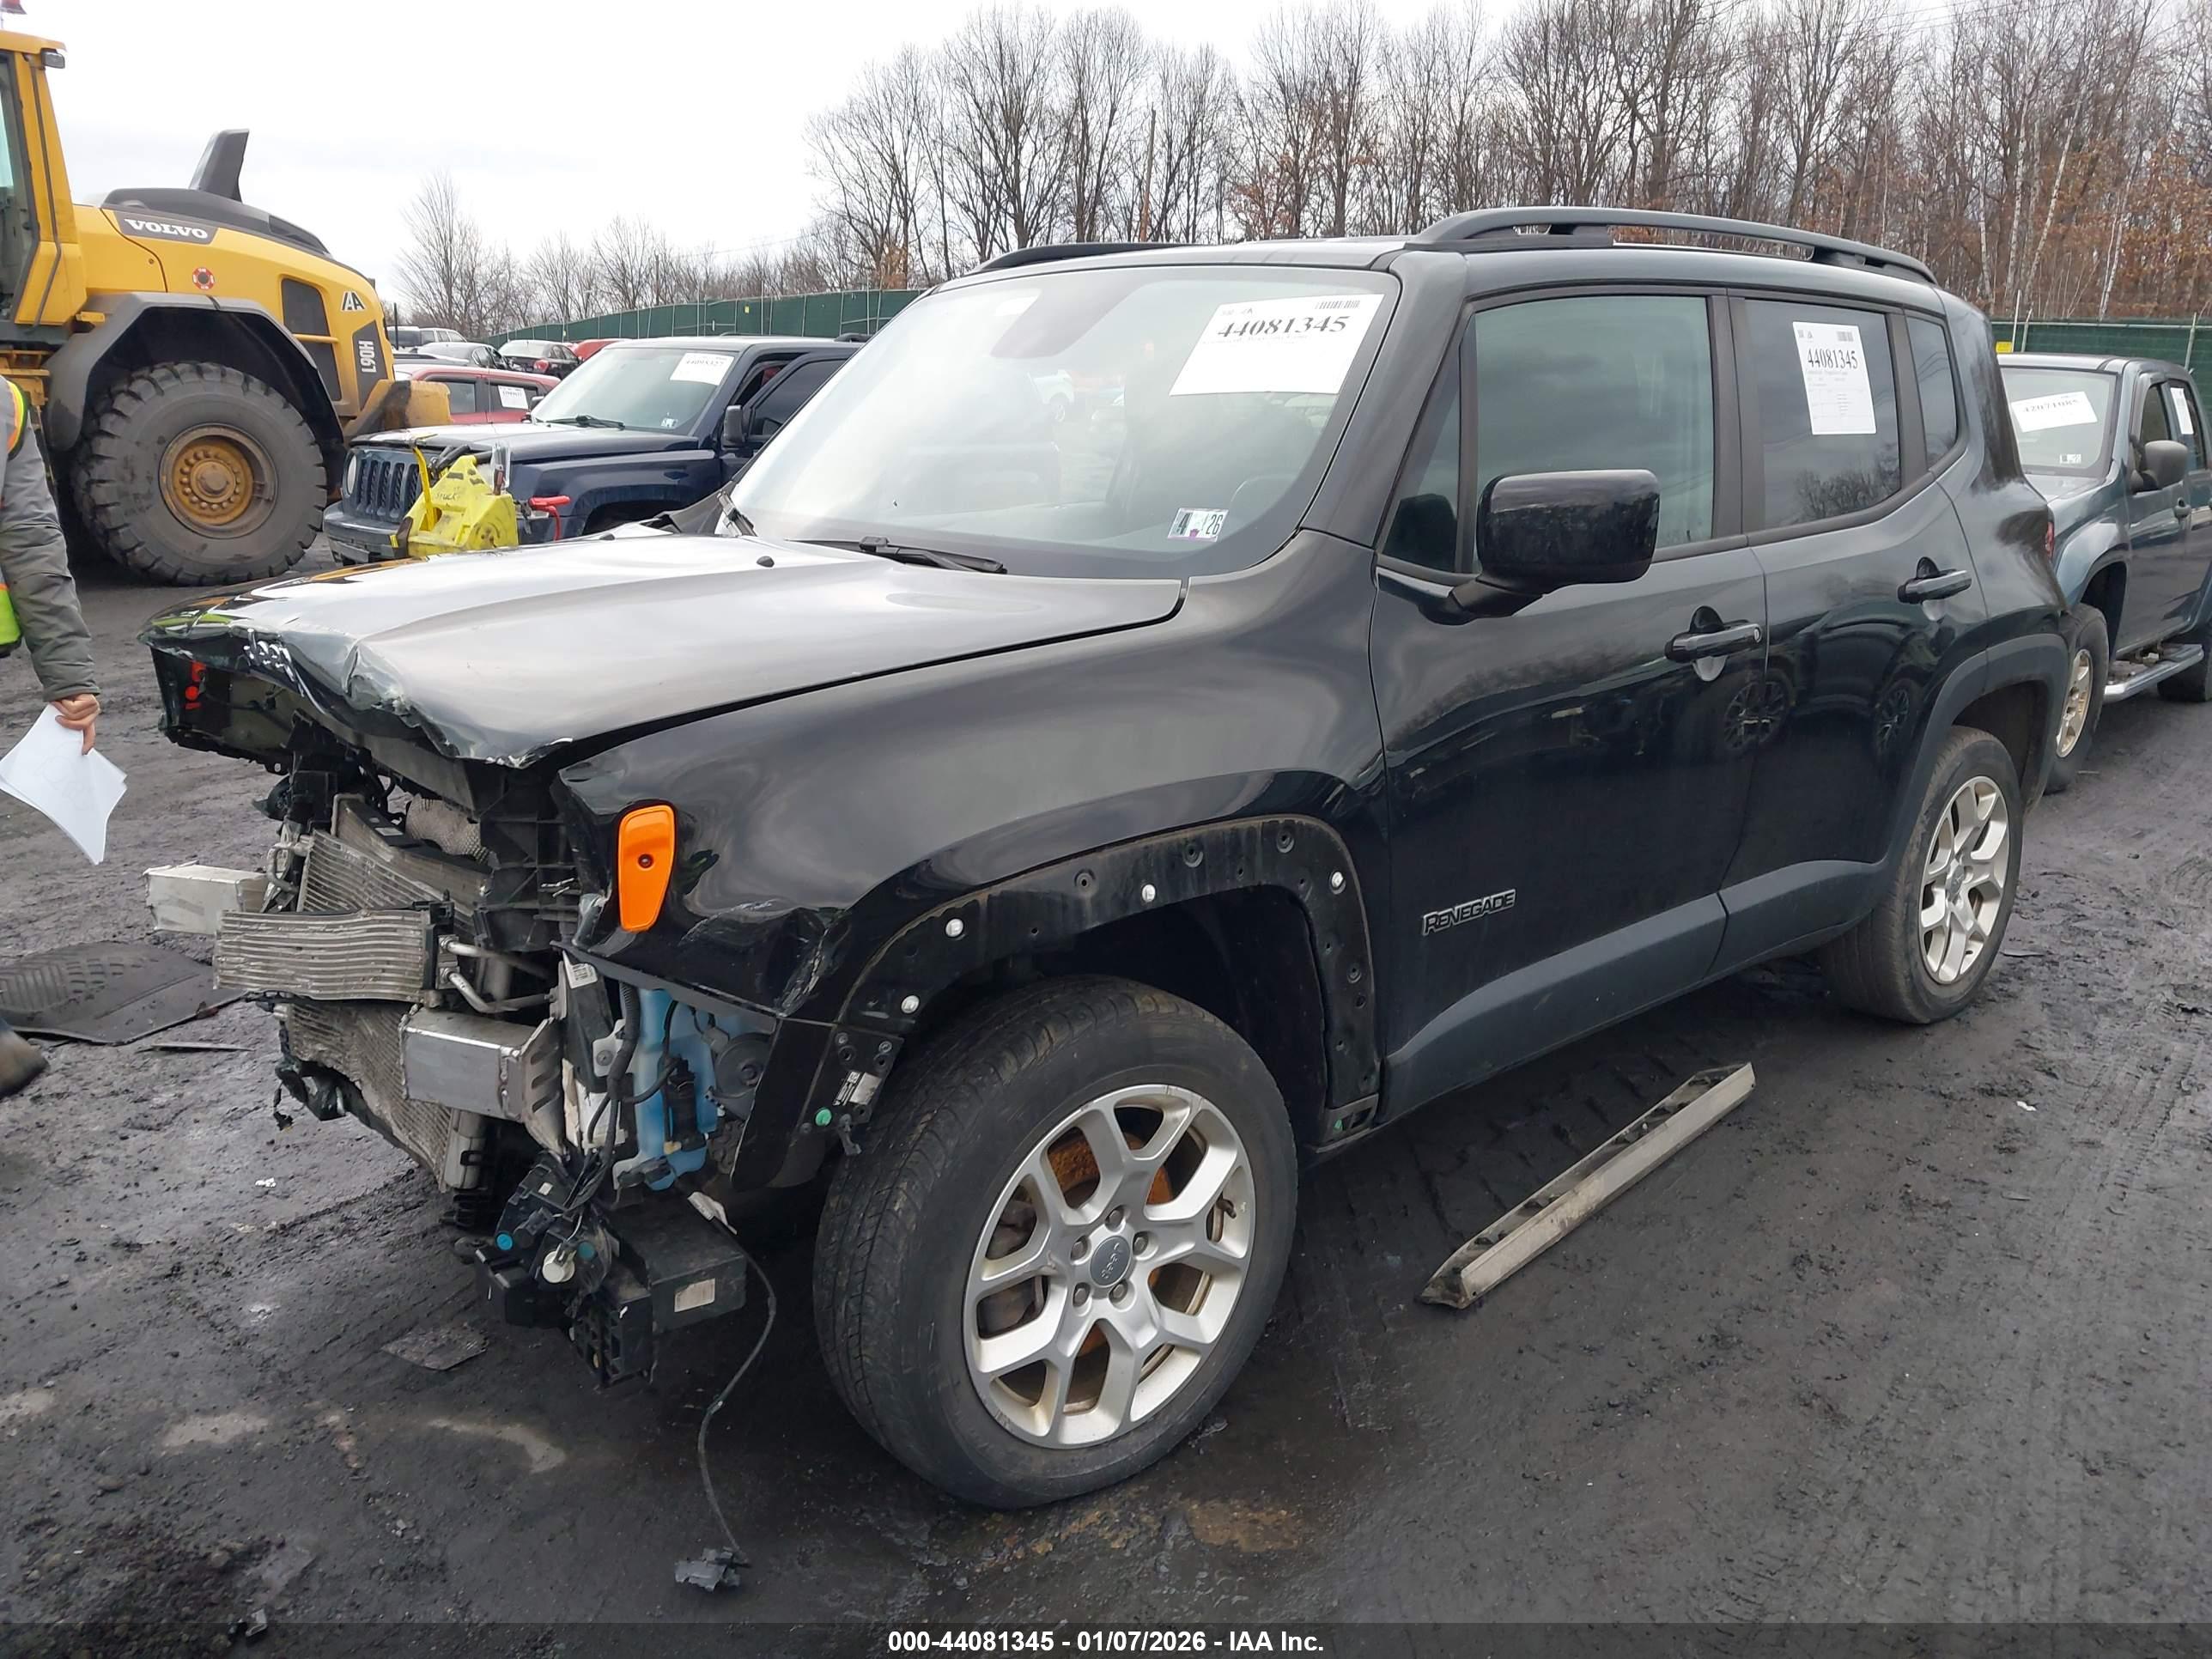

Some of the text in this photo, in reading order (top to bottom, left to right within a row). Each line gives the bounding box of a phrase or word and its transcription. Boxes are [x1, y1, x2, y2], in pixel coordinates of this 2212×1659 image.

[124, 218, 209, 239] VOLVO
[1218, 314, 1351, 337] 44081345
[358, 340, 378, 373] L90H
[1807, 347, 1859, 369] 44081345
[1422, 888, 1516, 936] RENEGADE
